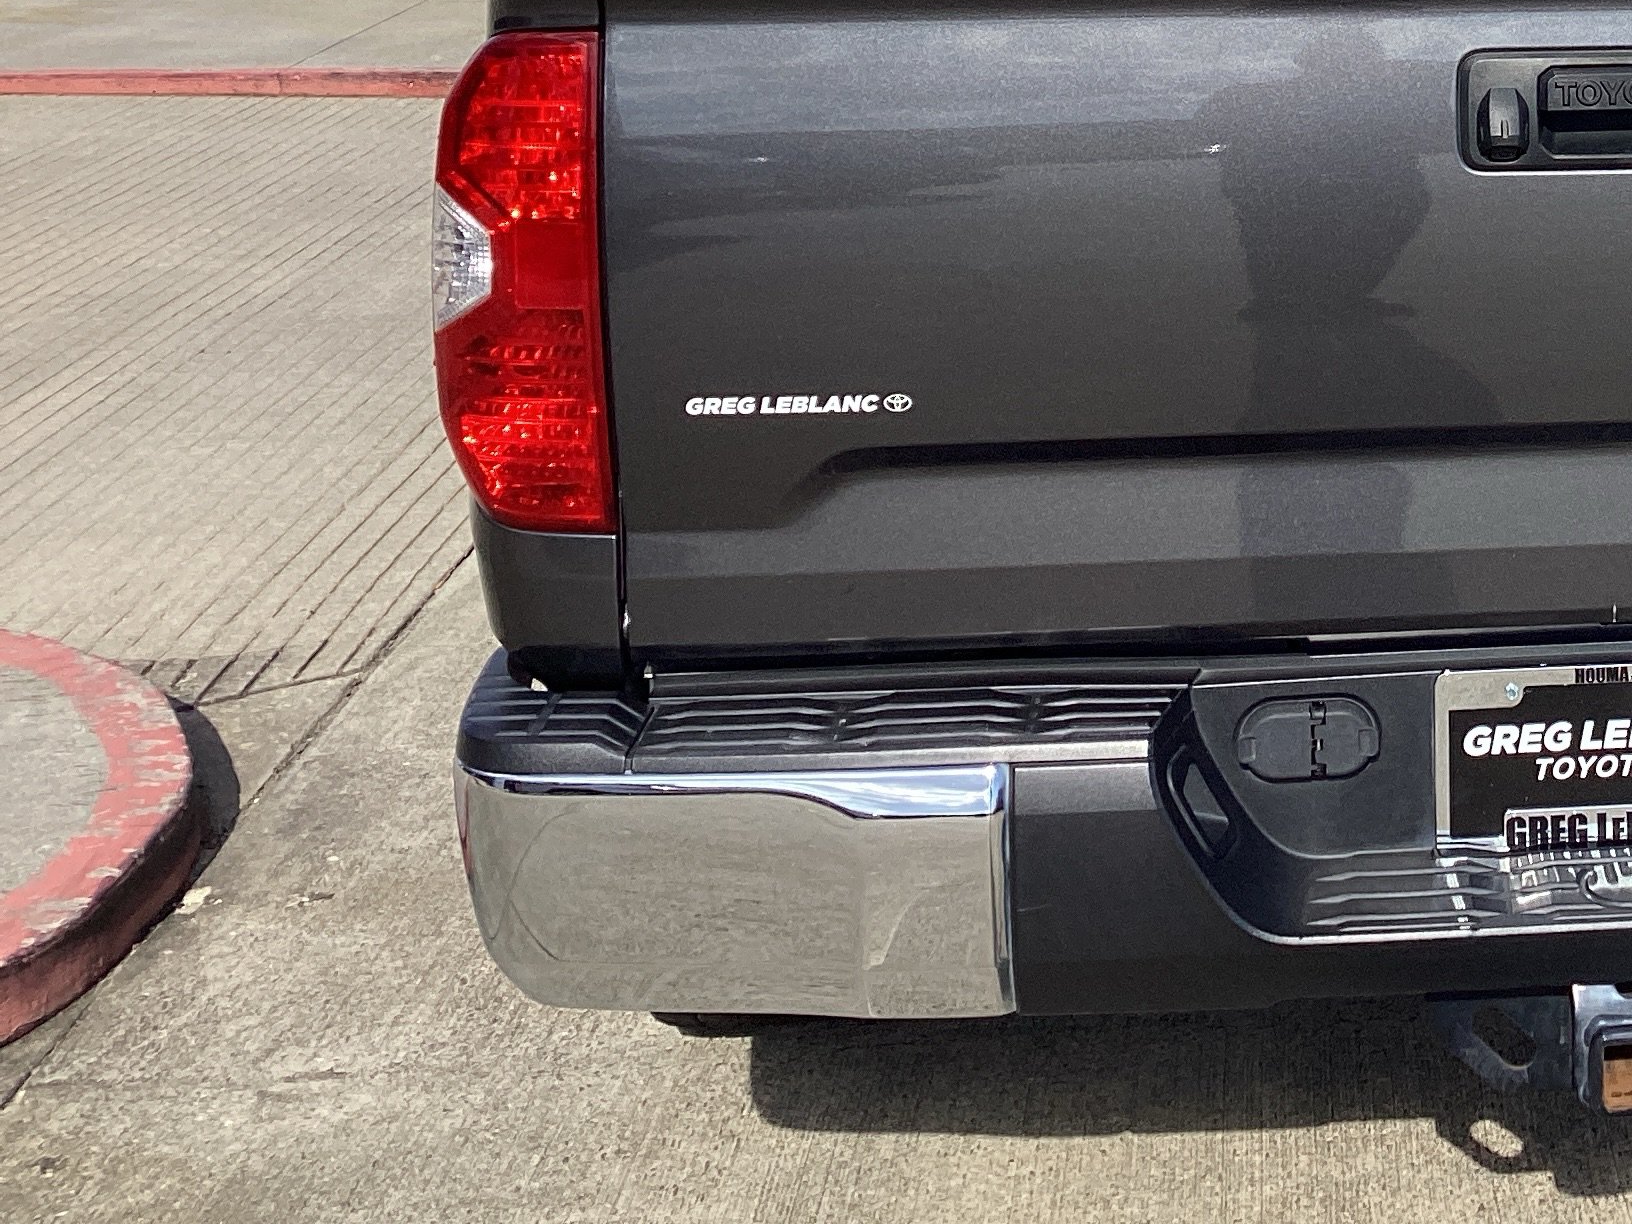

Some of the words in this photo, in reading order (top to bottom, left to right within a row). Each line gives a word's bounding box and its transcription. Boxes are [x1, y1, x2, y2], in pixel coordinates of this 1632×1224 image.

[685, 396, 756, 416] GREG
[760, 394, 880, 415] LEBLANC
[1463, 722, 1572, 757] GREG
[1505, 813, 1587, 850] GREG
